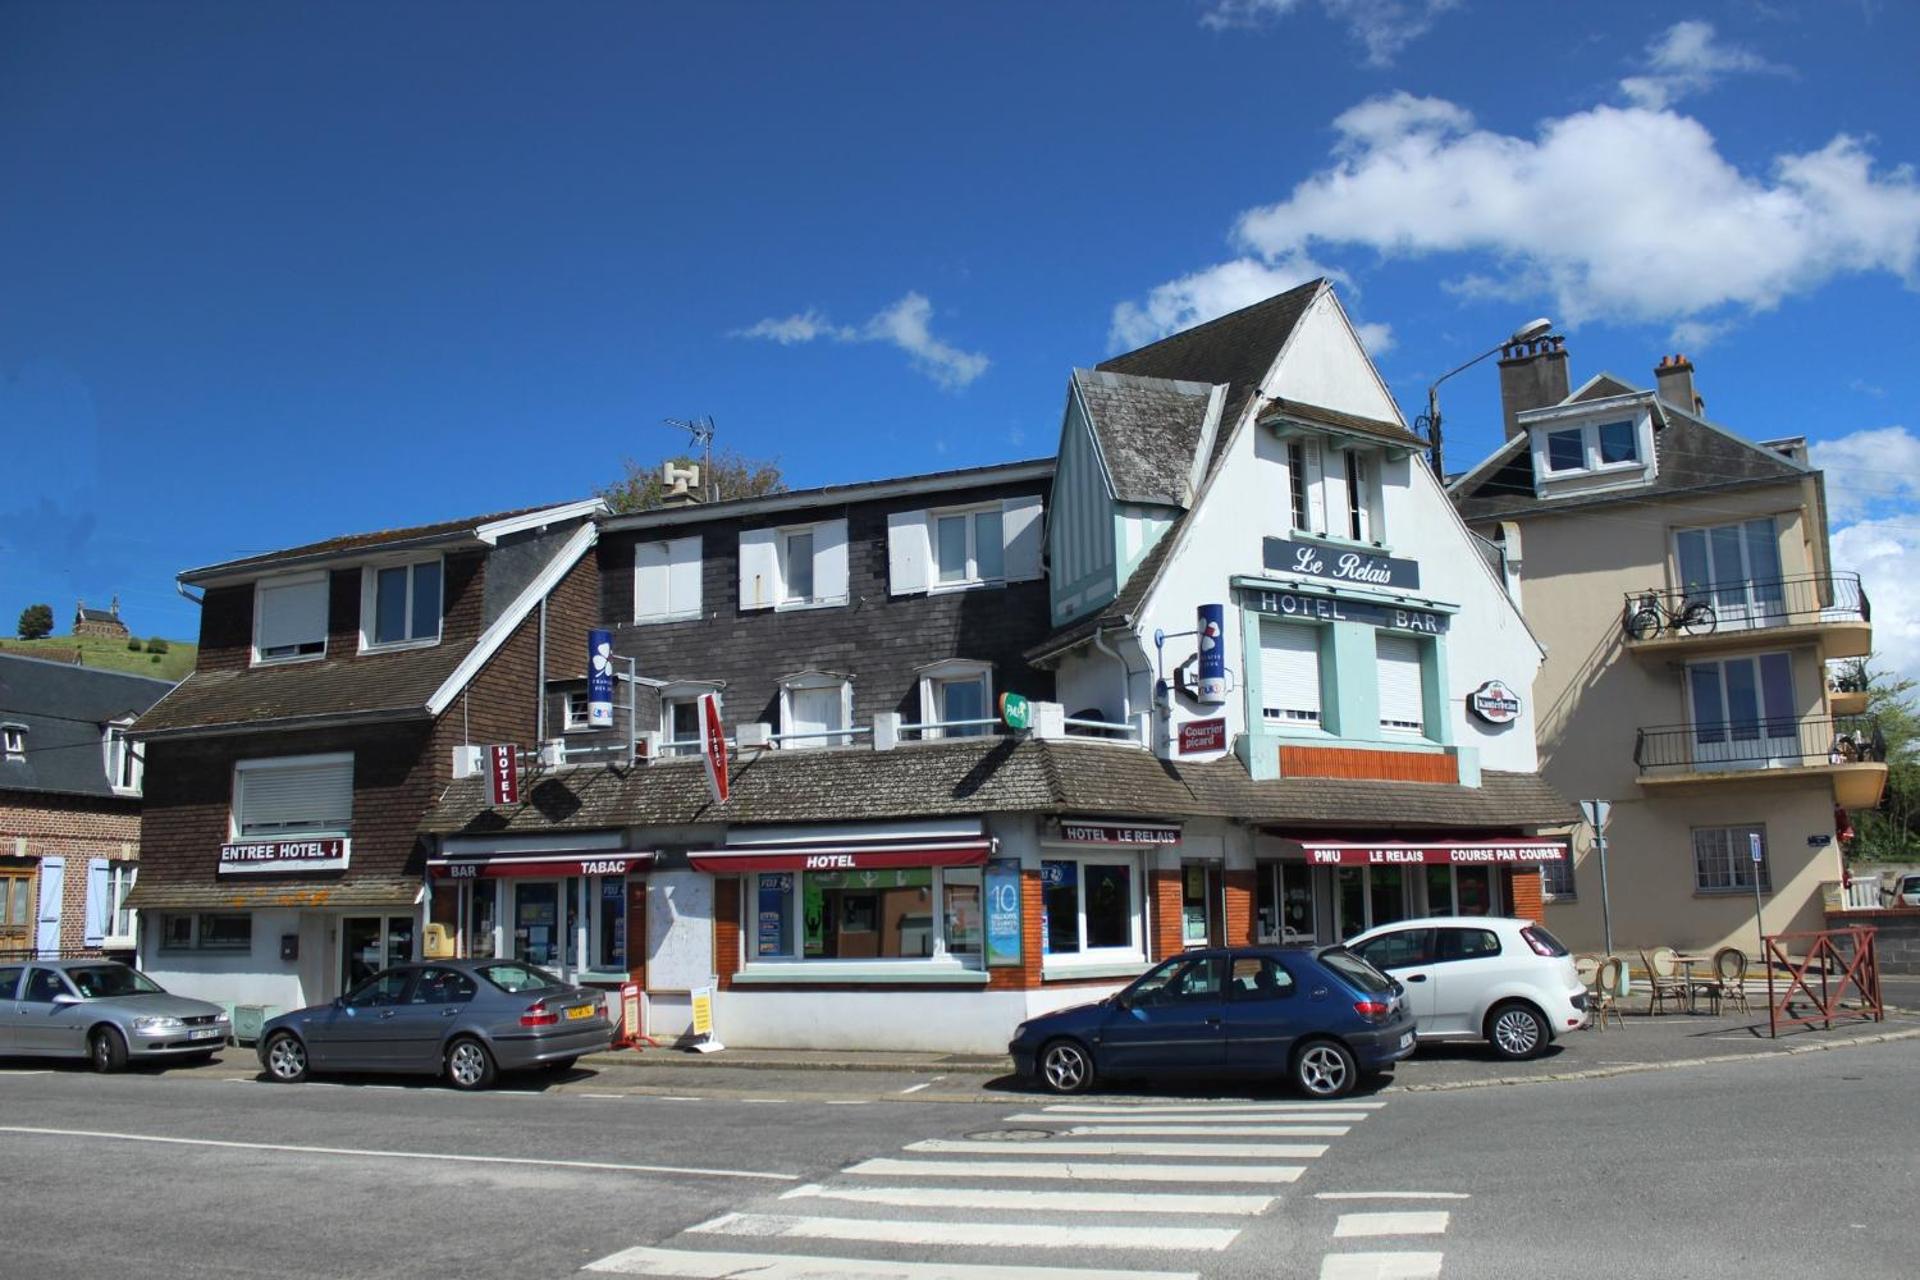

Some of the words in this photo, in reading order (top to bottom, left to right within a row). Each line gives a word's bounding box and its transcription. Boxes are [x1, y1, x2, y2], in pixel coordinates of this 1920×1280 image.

[1292, 547, 1323, 574] Le
[1333, 553, 1391, 584] Relais
[1260, 592, 1346, 620] HOTEL
[1395, 609, 1437, 632] BAR
[1185, 725, 1223, 737] Courrier
[711, 729, 721, 768] TABAC
[1185, 735, 1214, 749] picard
[498, 746, 510, 803] HOTEL
[1067, 827, 1108, 841] HOTEL
[1117, 830, 1132, 842] LE
[1134, 830, 1176, 844] RELAIS
[221, 845, 275, 860] ENTREE
[280, 843, 325, 857] HOTEL
[1314, 850, 1341, 862] PMU
[1369, 850, 1384, 862] LE
[1386, 849, 1424, 862] RELAIS
[1451, 850, 1494, 862] COURSE
[1496, 849, 1517, 861] PAR
[1520, 847, 1561, 860] COURSE
[581, 861, 626, 874] TABAC
[806, 854, 856, 868] HOTEL
[451, 865, 477, 878] BAR
[992, 884, 1016, 912] 10
